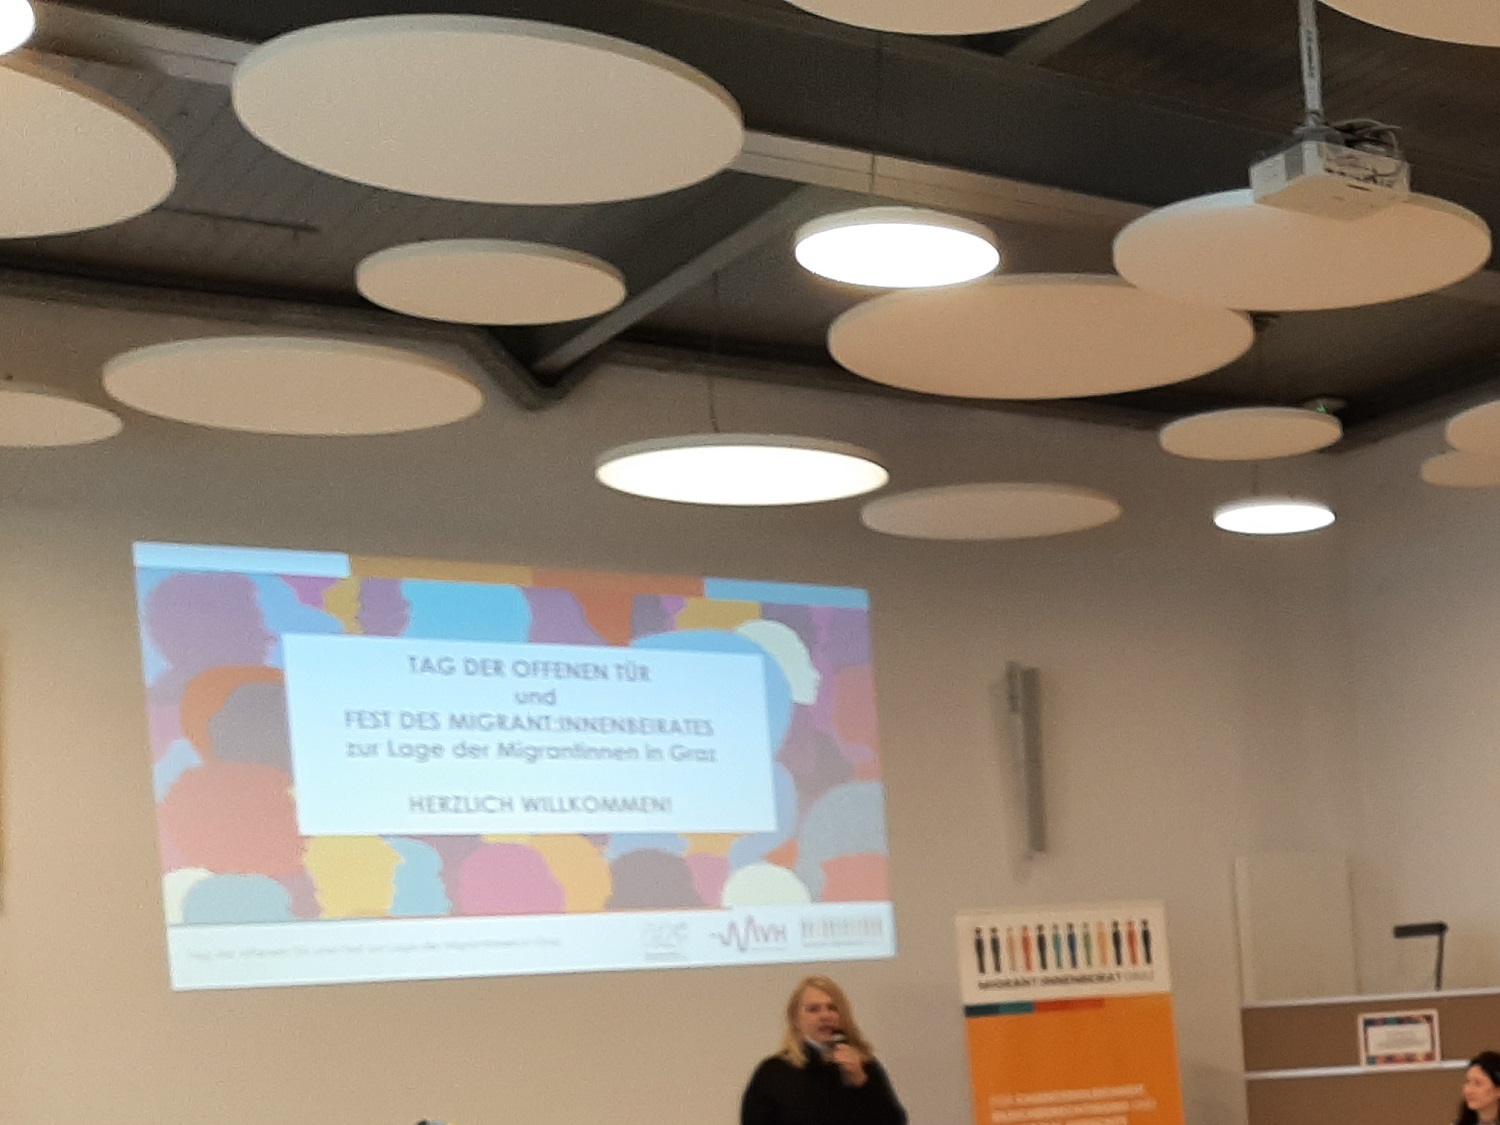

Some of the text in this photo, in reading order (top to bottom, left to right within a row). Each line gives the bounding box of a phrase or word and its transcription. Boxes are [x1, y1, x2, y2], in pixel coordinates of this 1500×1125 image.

[408, 655, 651, 681] TAG DER OFFENEN TÜR
[515, 689, 557, 706] und
[346, 710, 390, 729] FEST
[400, 711, 441, 730] DES
[347, 742, 379, 758] zur
[387, 740, 445, 763] Lage
[453, 740, 489, 759] der
[645, 744, 664, 761] in
[670, 744, 717, 762] Graz
[408, 795, 670, 814] HERZLICH WILLKOMMEN!
